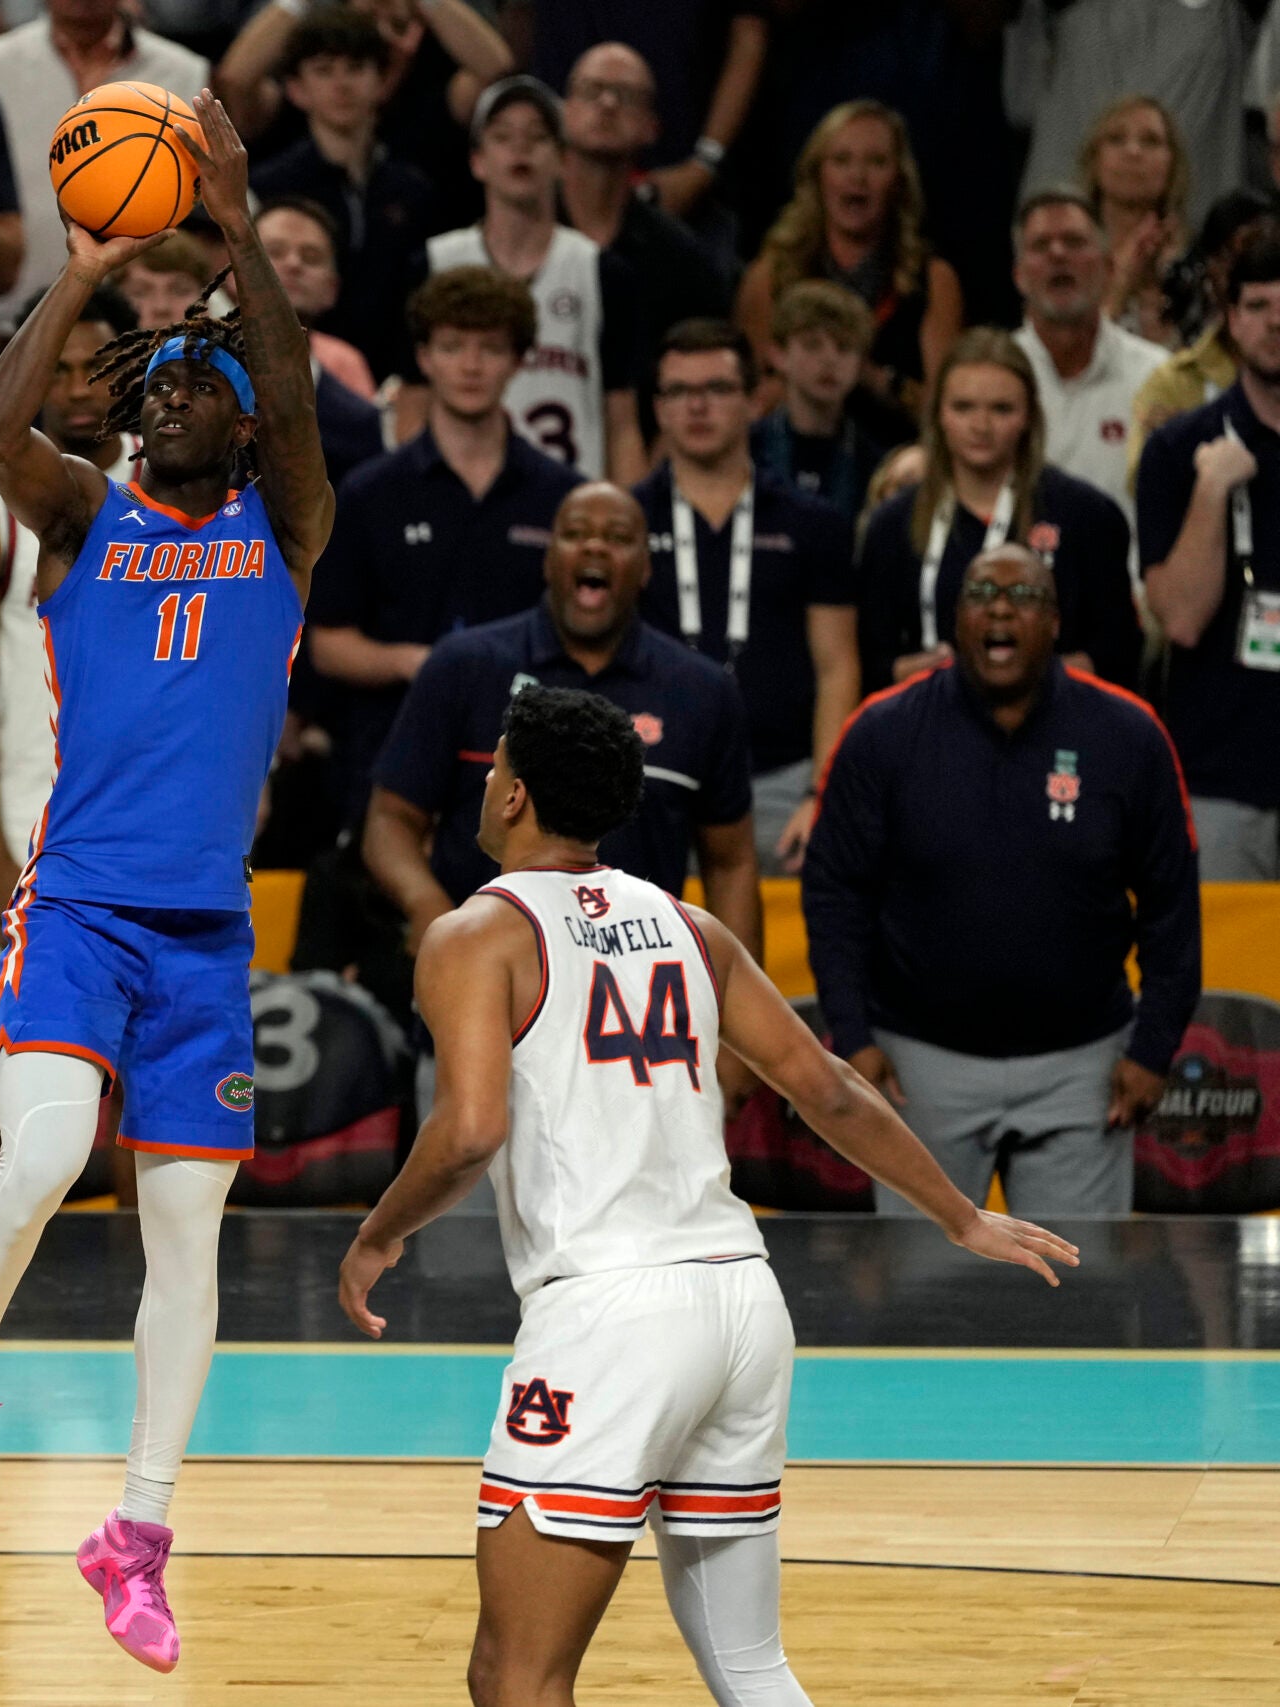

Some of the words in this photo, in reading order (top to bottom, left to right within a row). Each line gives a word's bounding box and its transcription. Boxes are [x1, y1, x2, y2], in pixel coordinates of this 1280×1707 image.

[96, 540, 265, 581] FLORIDA
[154, 593, 207, 660] 11
[583, 960, 702, 1093] 44
[1195, 1088, 1258, 1118] FOUR
